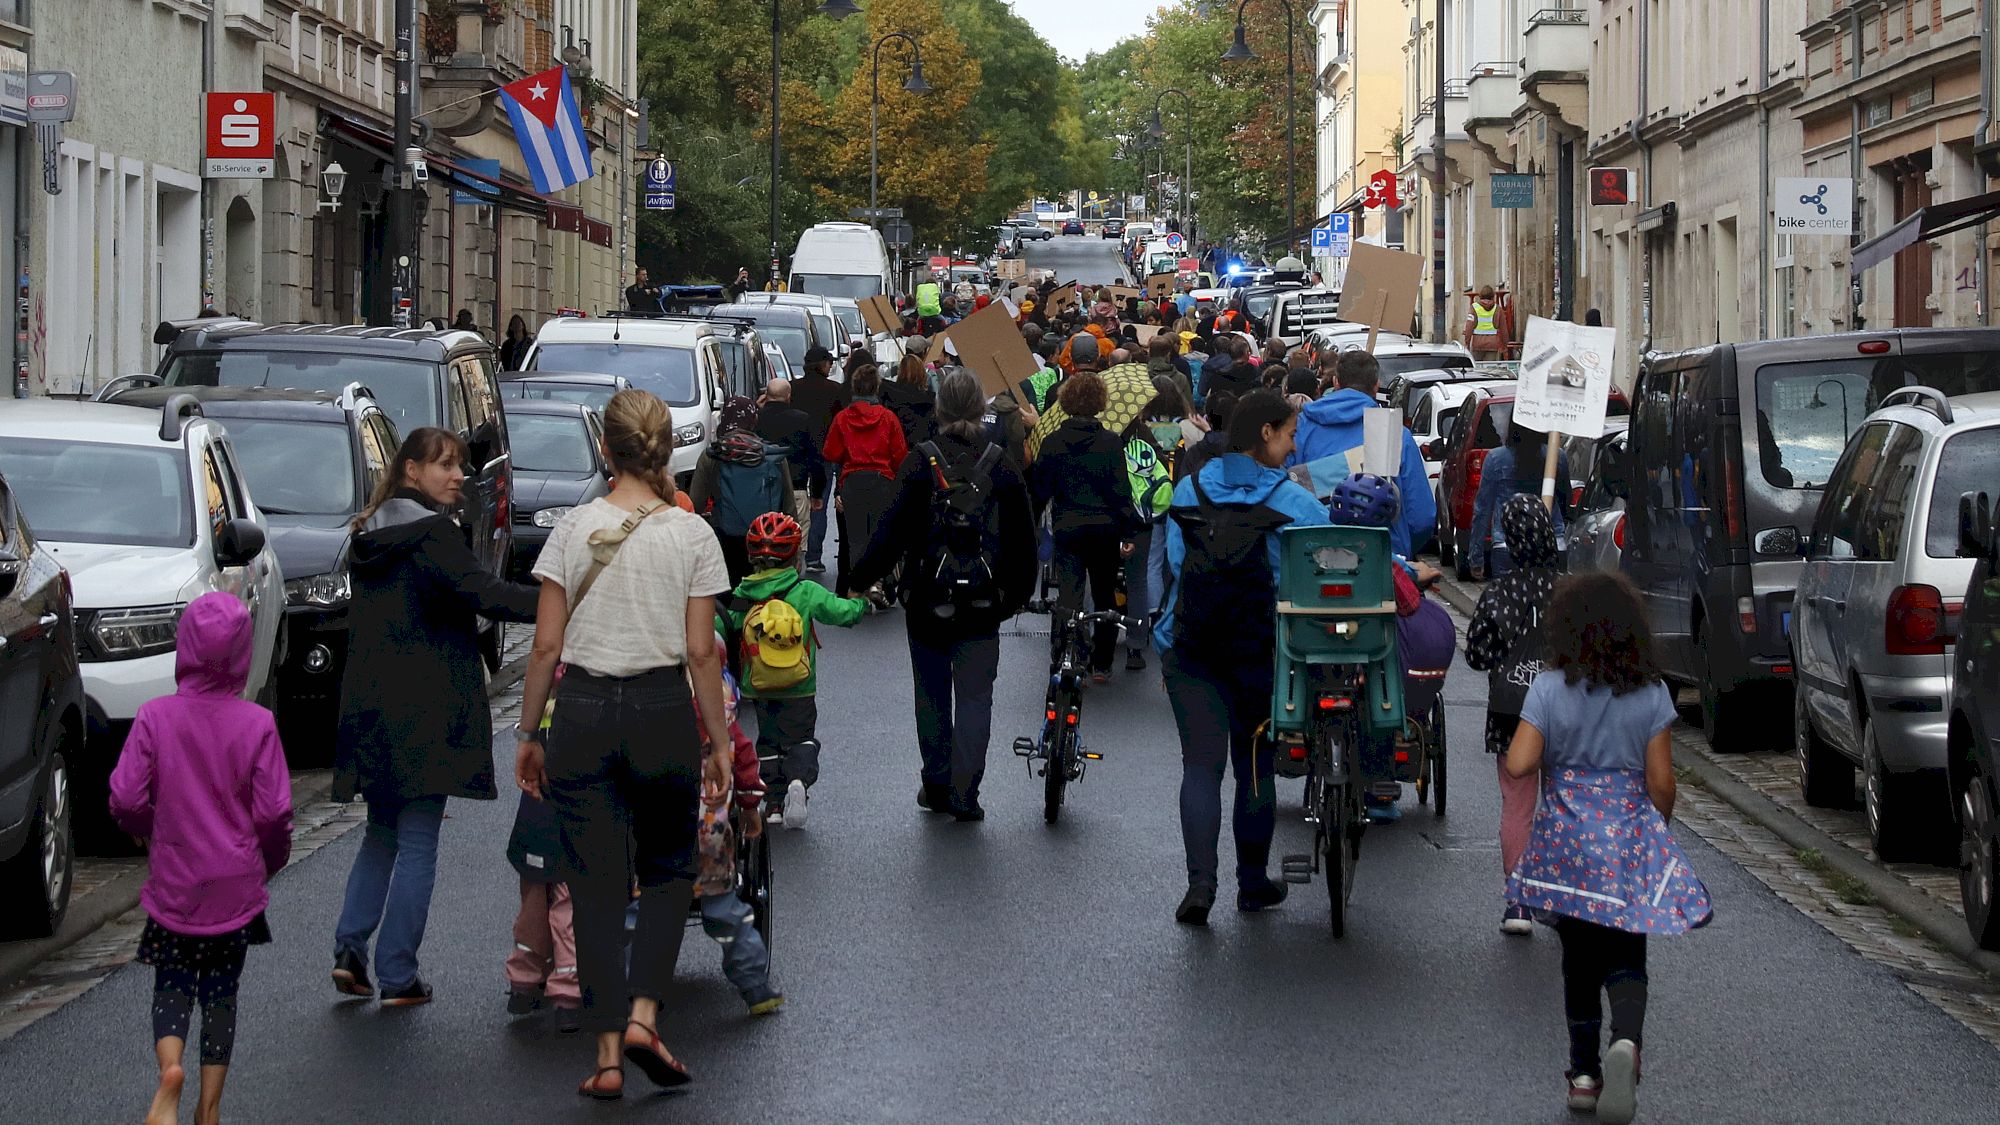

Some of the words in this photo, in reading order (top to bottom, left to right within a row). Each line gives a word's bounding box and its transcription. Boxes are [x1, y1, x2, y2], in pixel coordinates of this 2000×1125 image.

[211, 164, 252, 173] SB-Service
[1334, 216, 1345, 231] P
[1778, 216, 1806, 228] bike
[1808, 217, 1849, 229] center
[1316, 230, 1327, 245] P
